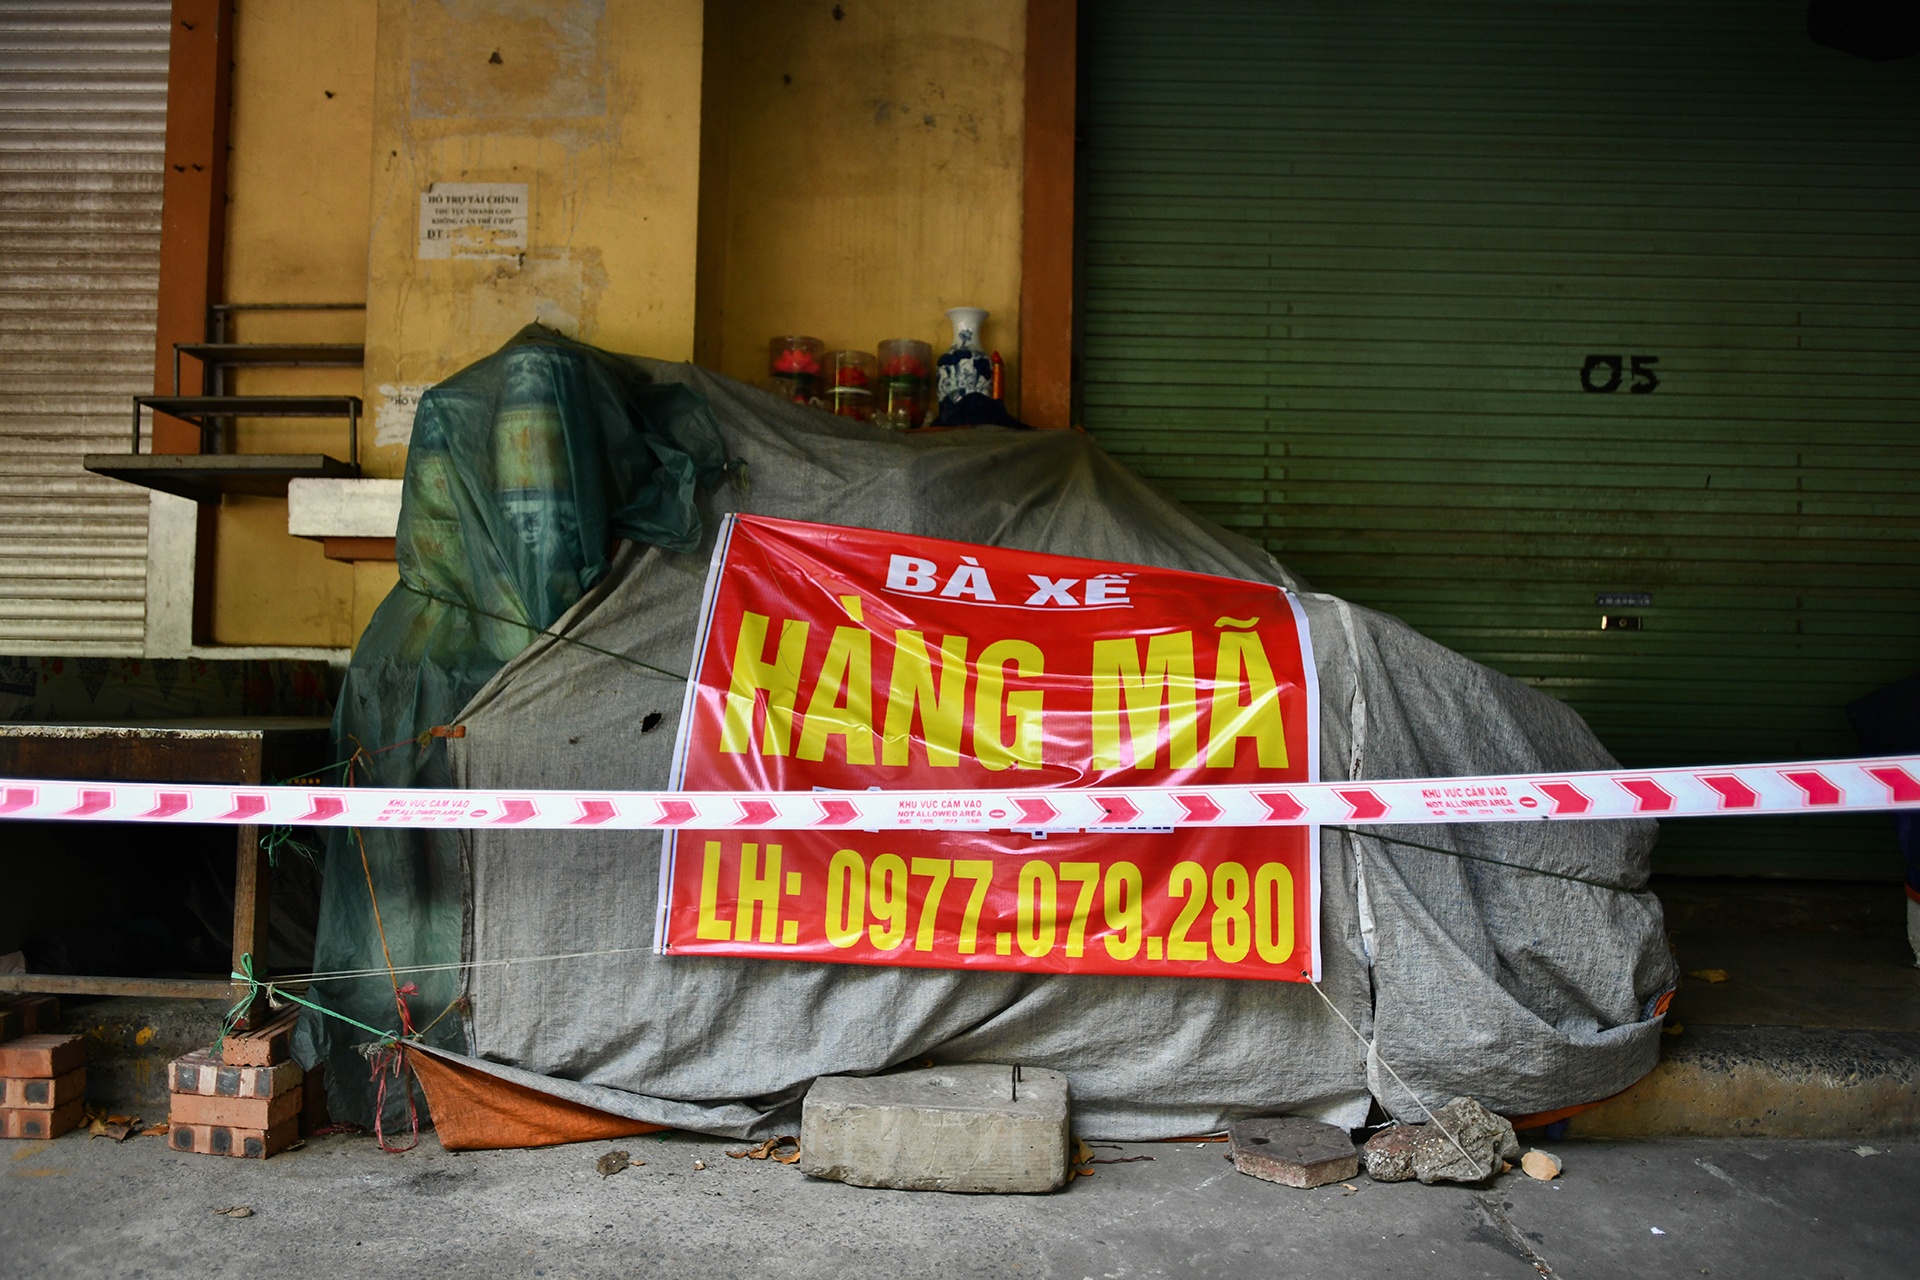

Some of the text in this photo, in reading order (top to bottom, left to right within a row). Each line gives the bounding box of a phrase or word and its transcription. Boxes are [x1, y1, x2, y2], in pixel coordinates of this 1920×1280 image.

[1580, 354, 1660, 394] 05
[885, 553, 1140, 606] BÀ XẾ
[718, 595, 1290, 771] HÀNG MÃ
[388, 799, 407, 807] KHU
[899, 800, 918, 808] KHU
[1421, 788, 1442, 799] KHU
[1425, 798, 1515, 809] NOT ALLOWED AREA
[697, 840, 1296, 965] LH: 0977.079.280
